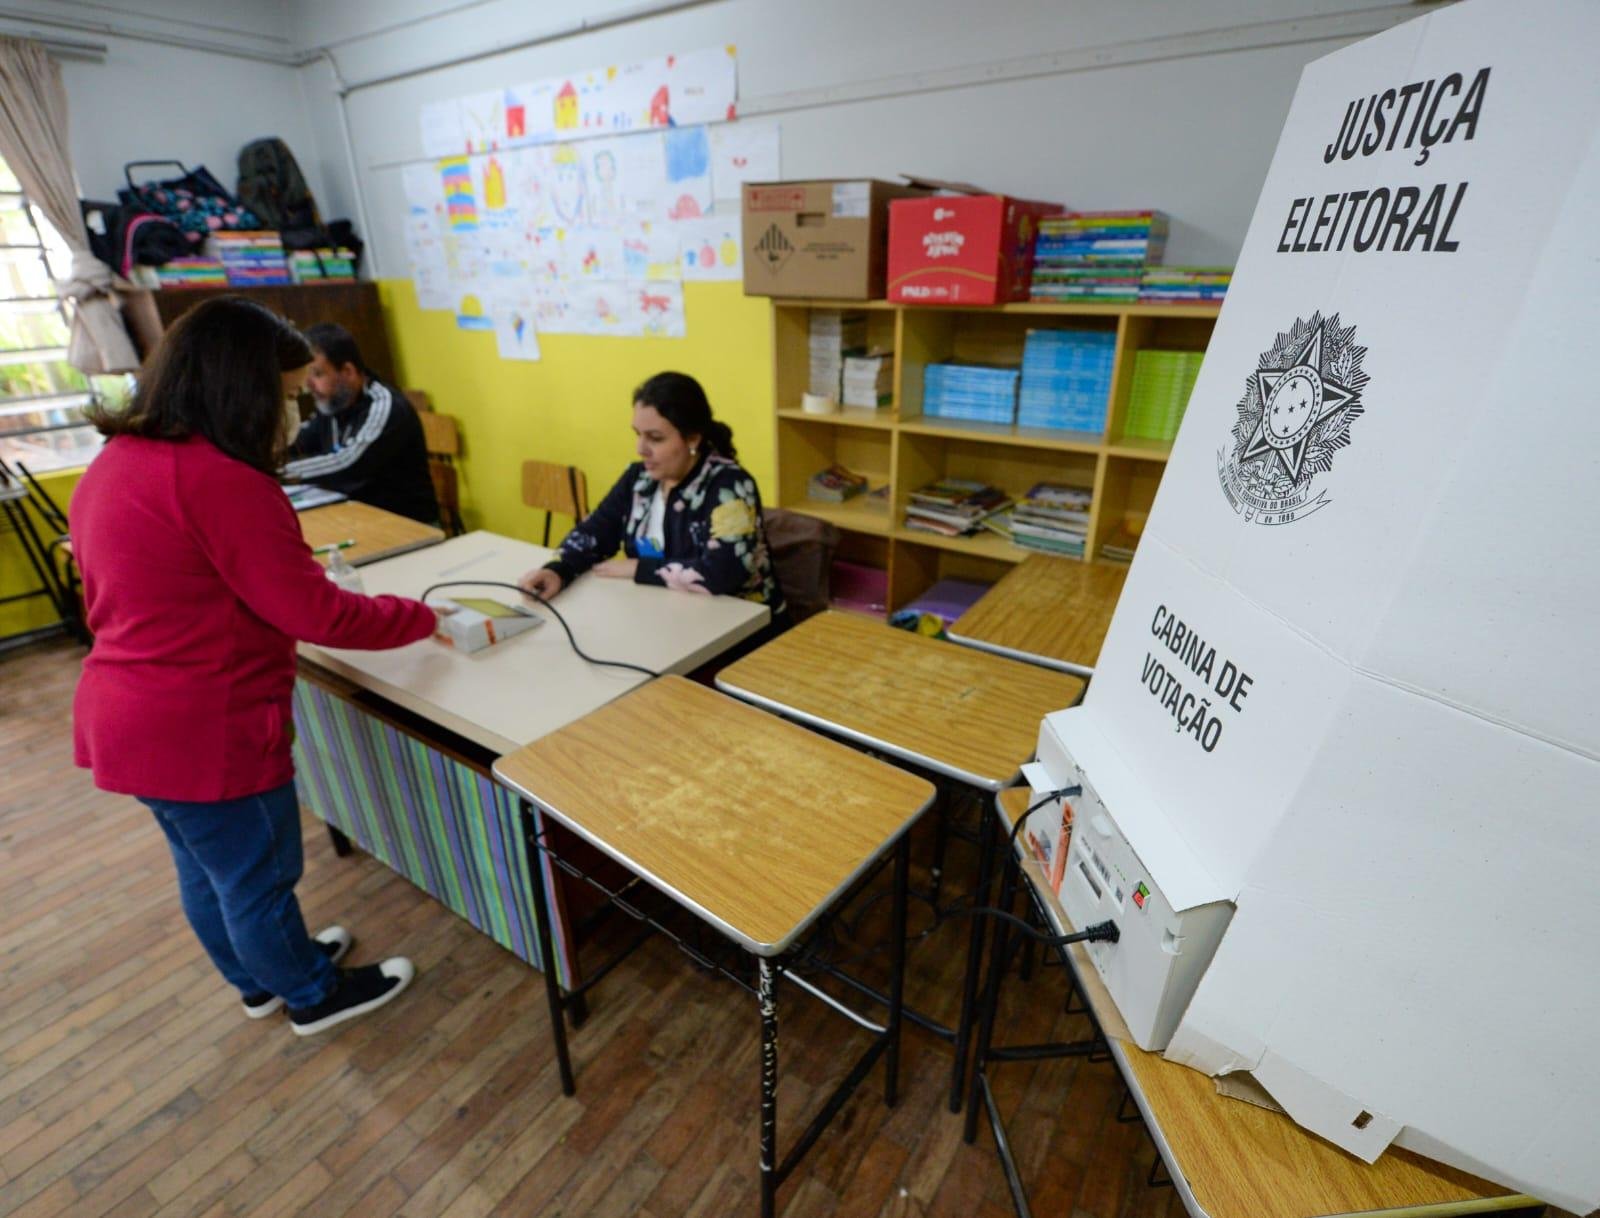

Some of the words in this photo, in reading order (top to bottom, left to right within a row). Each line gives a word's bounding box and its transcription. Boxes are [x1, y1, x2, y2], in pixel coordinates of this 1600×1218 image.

[1324, 67, 1492, 167] JUSTIÇA
[1276, 182, 1469, 253] ELEITORAL
[1280, 496, 1301, 508] BRASIL
[1141, 652, 1223, 753] VOTAÇÃO
[1151, 604, 1217, 685] CABINA
[1214, 660, 1254, 713] DE
